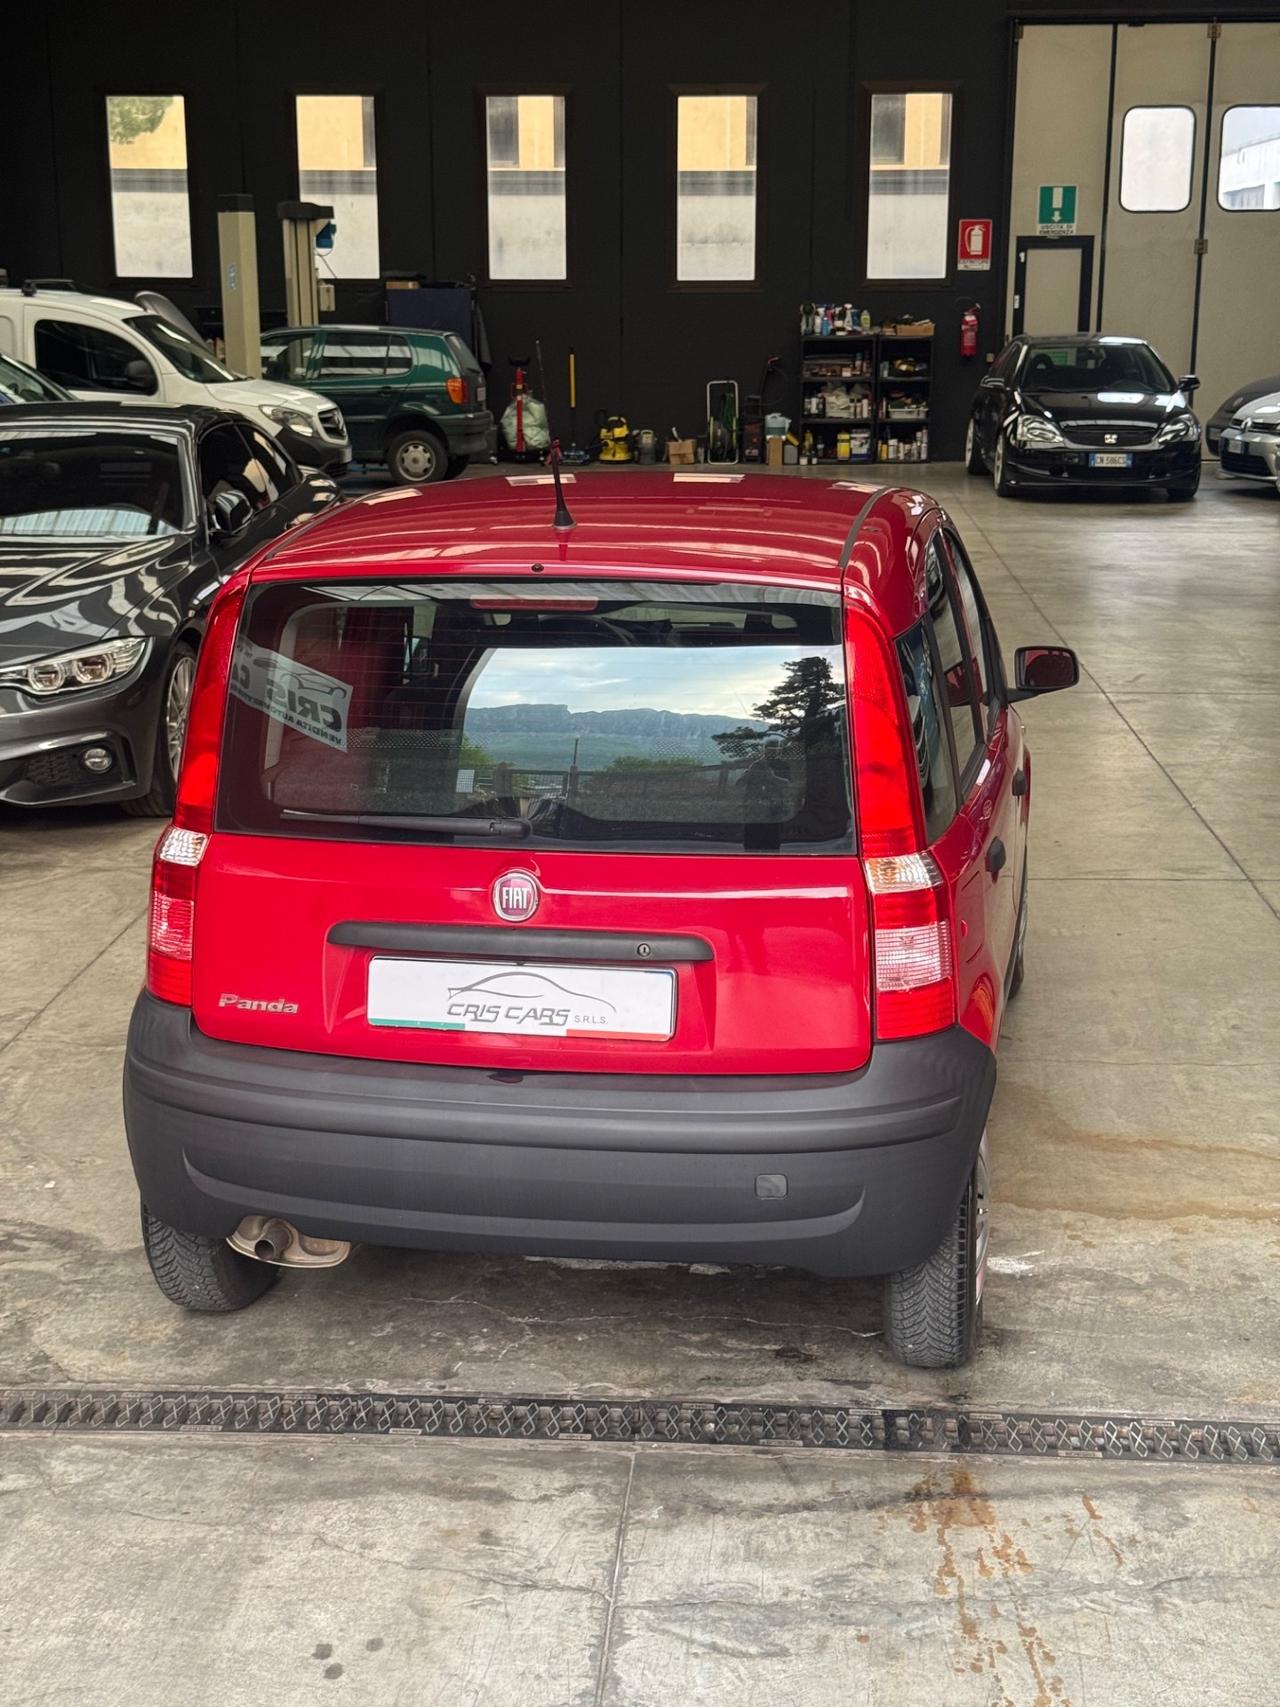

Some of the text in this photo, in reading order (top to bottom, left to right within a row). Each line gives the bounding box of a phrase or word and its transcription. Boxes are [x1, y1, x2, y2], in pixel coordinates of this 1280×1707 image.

[502, 886, 529, 909] FIAT
[218, 993, 299, 1014] Panda
[446, 1003, 500, 1023] CRIS
[504, 1006, 571, 1027] CARS
